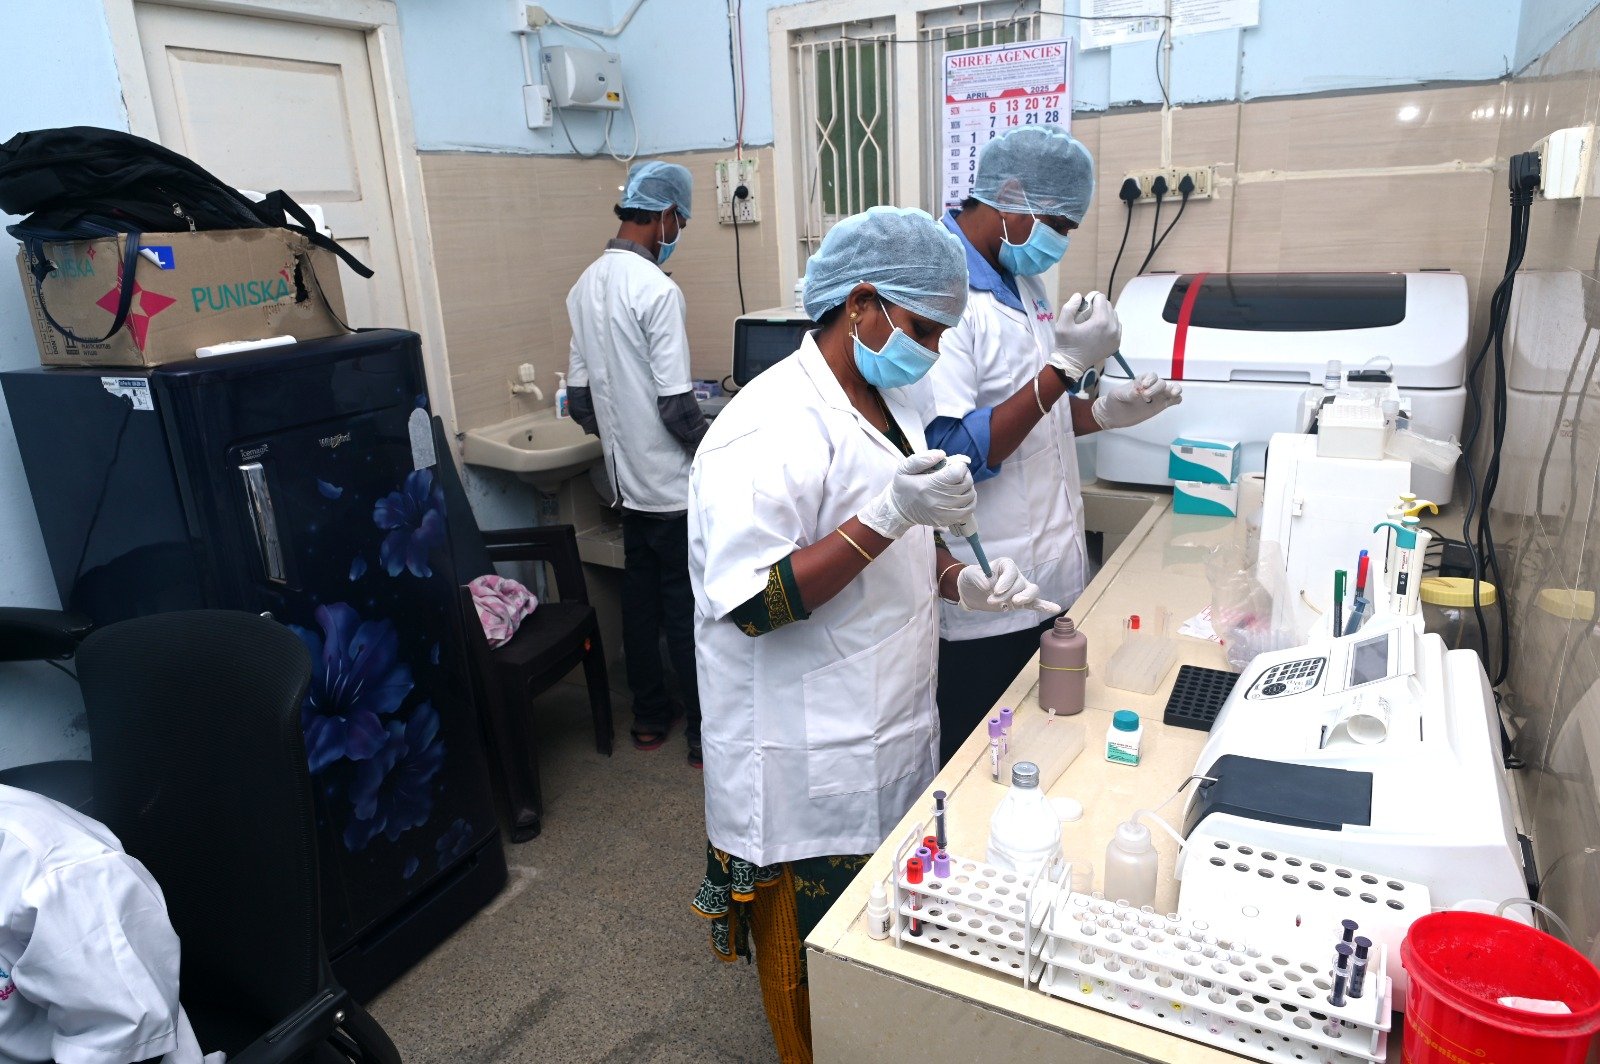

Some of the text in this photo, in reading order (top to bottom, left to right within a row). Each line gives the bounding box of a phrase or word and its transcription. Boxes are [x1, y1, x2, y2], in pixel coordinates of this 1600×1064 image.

[951, 45, 1061, 68] SHREE AGENCIES
[966, 85, 1049, 100] APRIL 2025
[989, 101, 996, 113] 6
[1006, 99, 1019, 112] 13
[1025, 97, 1039, 110] 20
[1045, 96, 1060, 108] 27
[989, 116, 996, 128] 7
[1006, 114, 1019, 126] 14
[1025, 112, 1038, 124] 21
[1045, 110, 1059, 123] 28
[971, 132, 976, 143] 1
[970, 146, 976, 157] 2
[969, 159, 975, 171] 3
[968, 173, 975, 184] 4
[191, 278, 289, 313] PUNISKA
